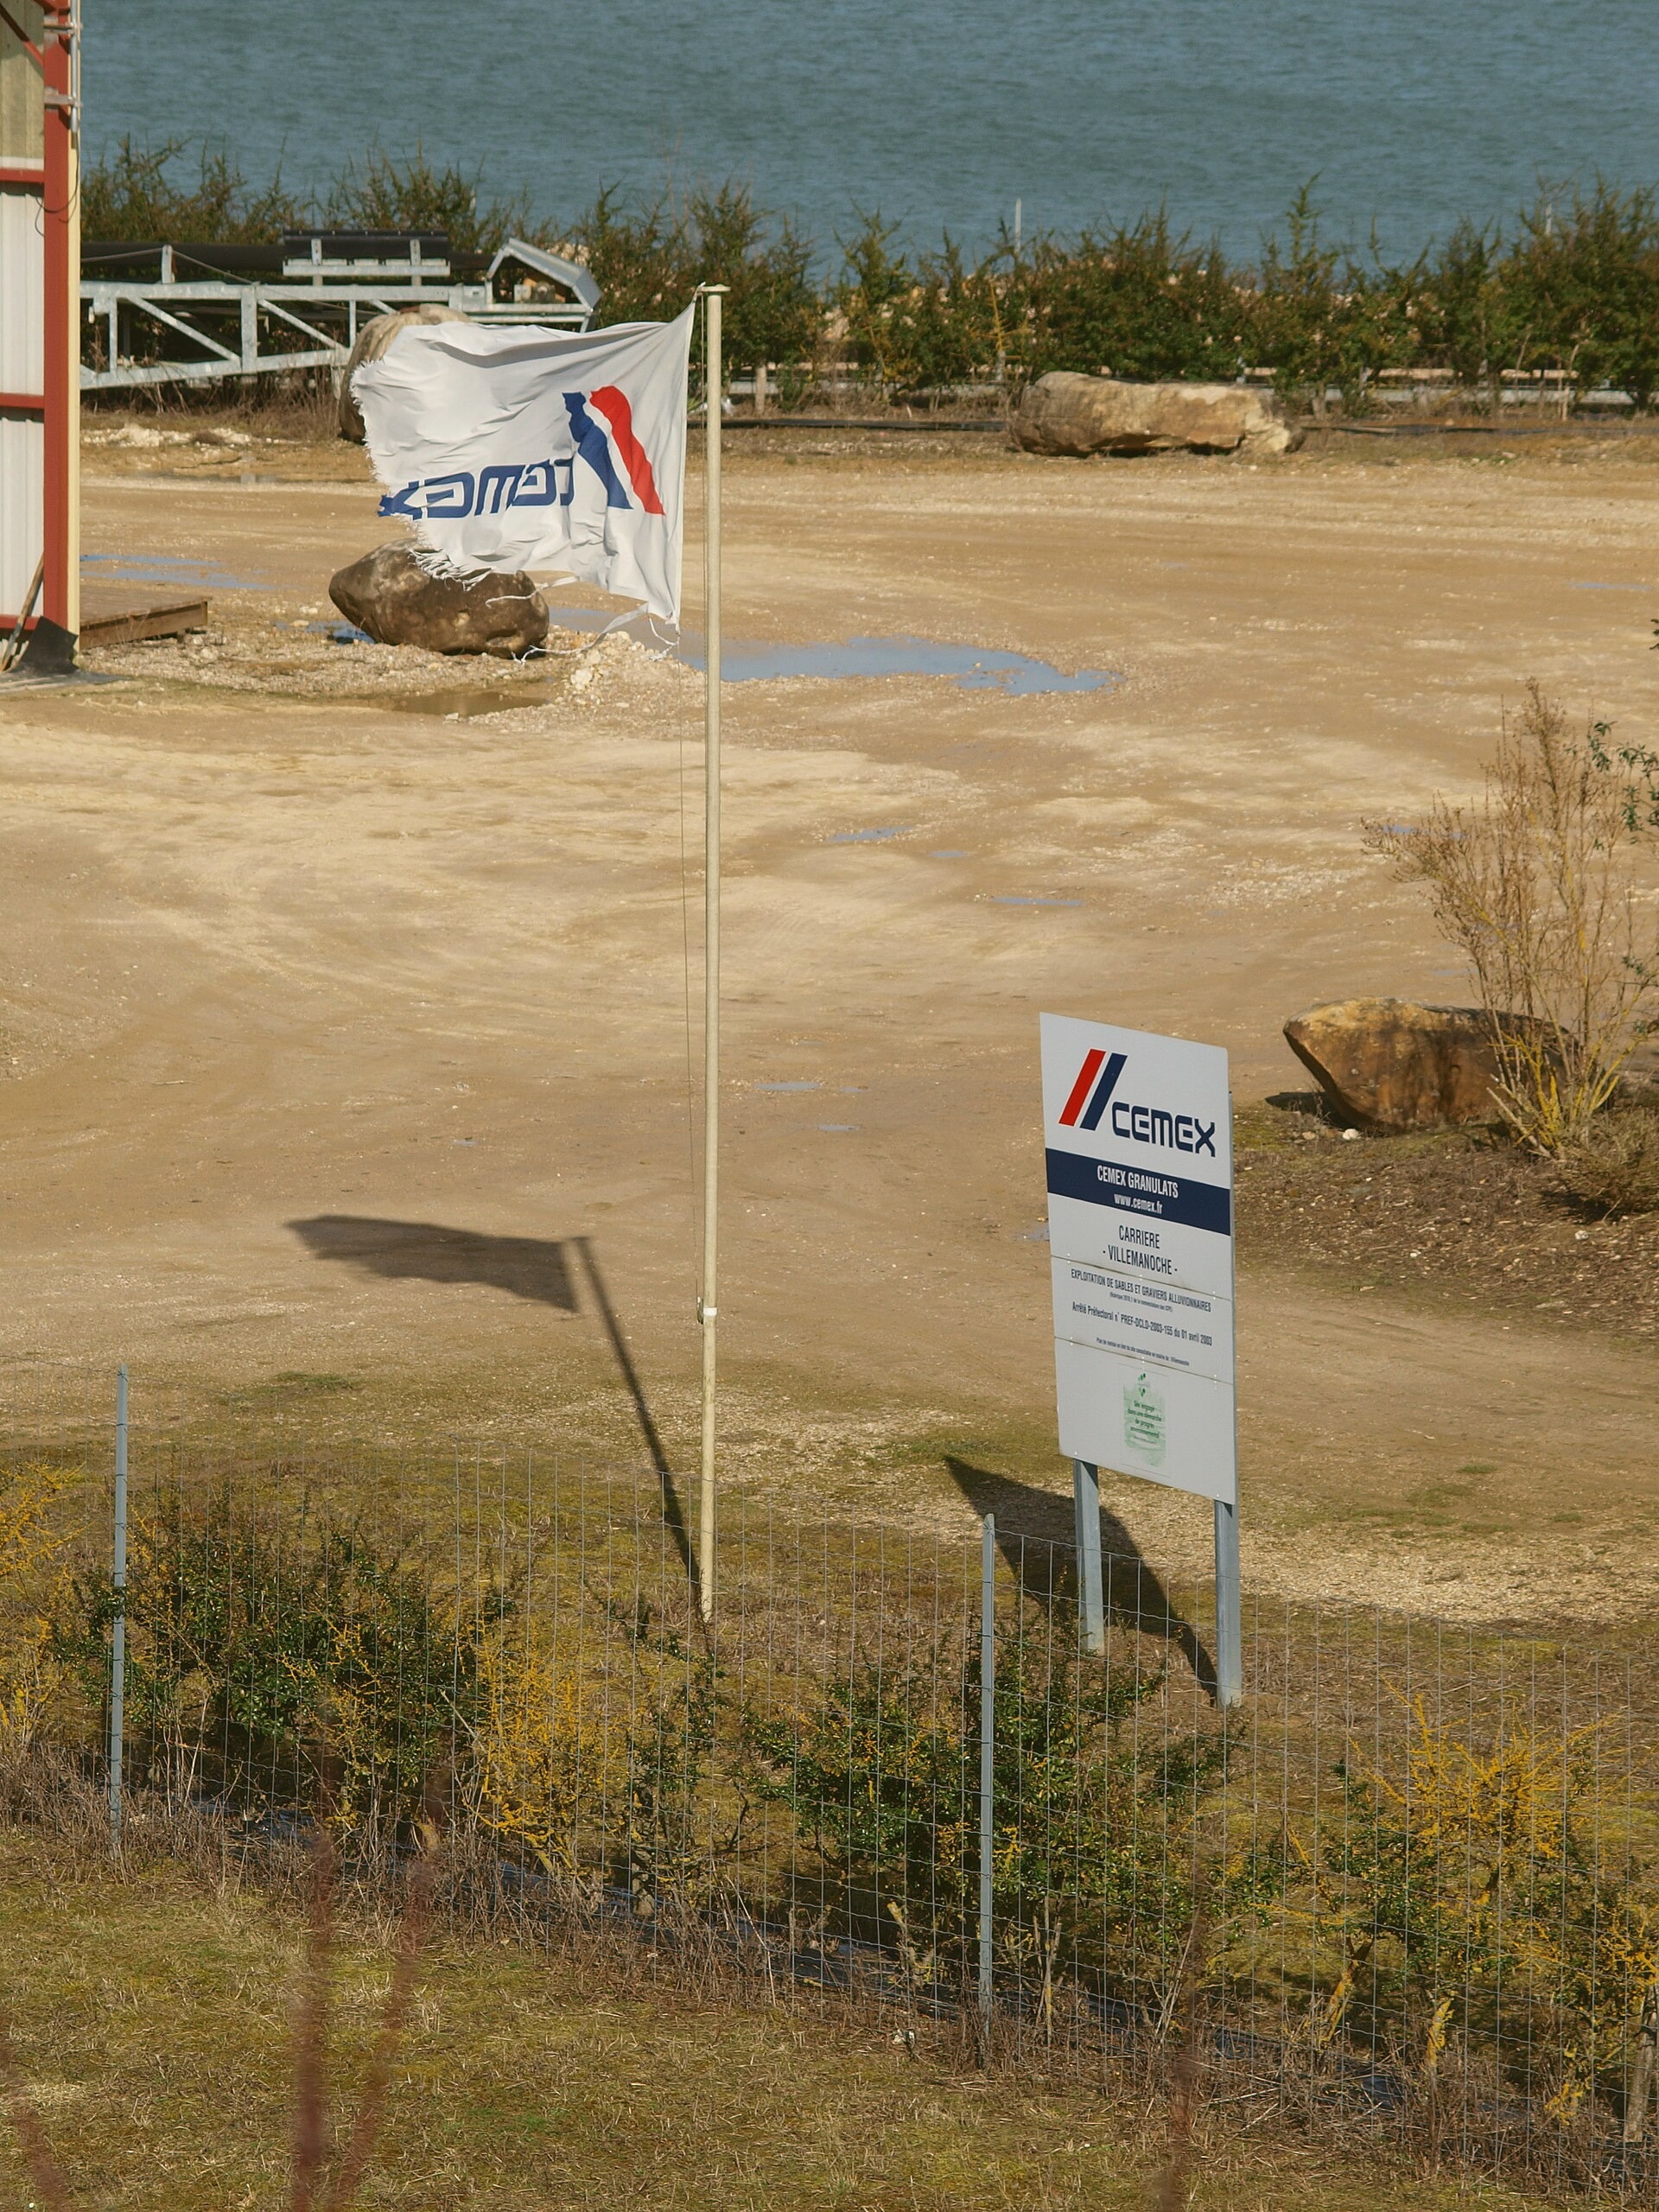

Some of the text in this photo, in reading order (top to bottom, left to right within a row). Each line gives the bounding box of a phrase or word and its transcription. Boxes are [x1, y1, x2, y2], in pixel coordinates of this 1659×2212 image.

[1111, 1101, 1216, 1158] CEMEX
[1096, 1165, 1179, 1198] CEMEX GRANULATS
[1114, 1193, 1163, 1214] www.cemex.fr
[1118, 1224, 1160, 1249] CARRIERE
[1108, 1244, 1173, 1275] VILLEMANOCHE
[1071, 1268, 1106, 1286] EXPLOITATION
[1107, 1277, 1114, 1288] DE
[1115, 1280, 1134, 1293] SABLES
[1135, 1284, 1141, 1294] ET
[1141, 1286, 1167, 1301] GRAVIERS
[1168, 1293, 1211, 1313] ALLUVIONNAIRES
[1174, 1327, 1180, 1338] du
[1181, 1329, 1187, 1339] 01
[1189, 1332, 1199, 1343] avril
[1200, 1334, 1212, 1346] 2003
